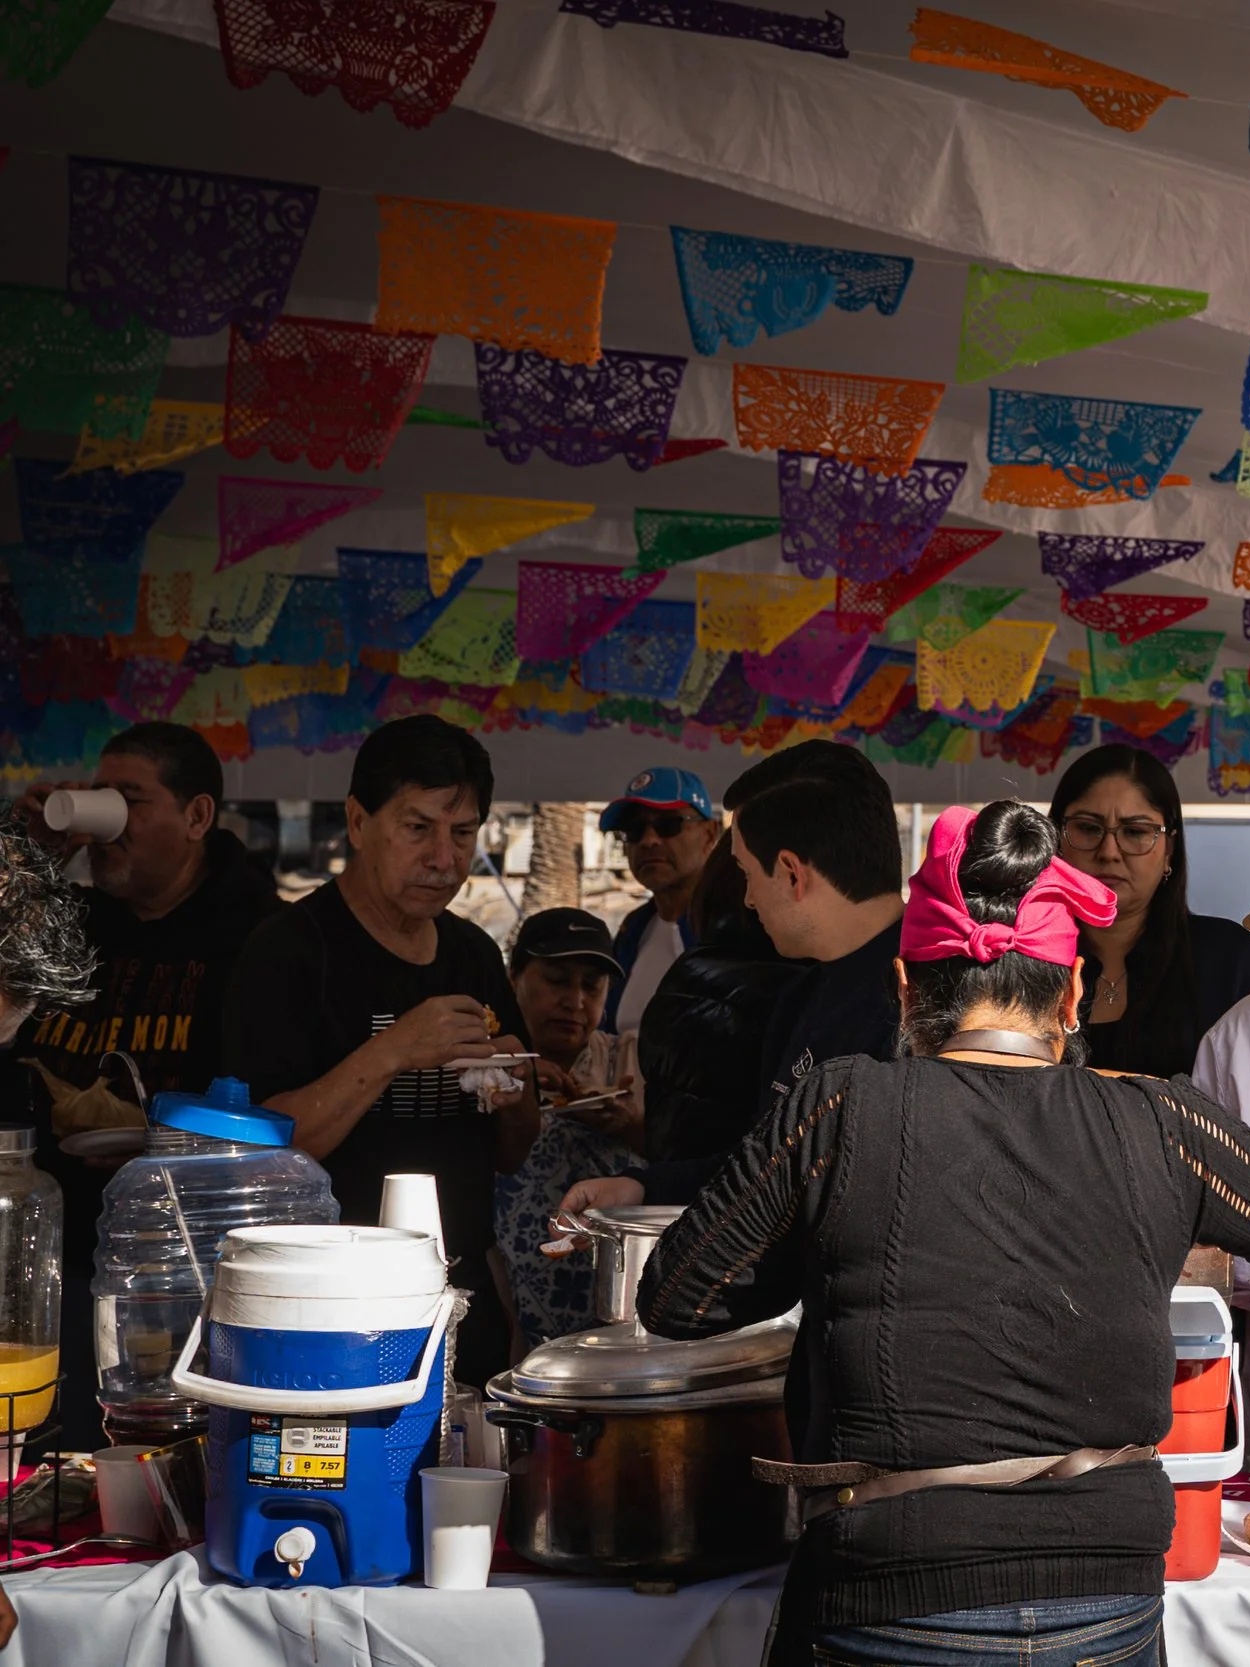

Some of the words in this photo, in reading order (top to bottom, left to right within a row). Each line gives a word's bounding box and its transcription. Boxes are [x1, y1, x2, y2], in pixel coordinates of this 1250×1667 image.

[130, 1014, 192, 1052] MOM
[286, 1461, 292, 1470] 2
[304, 1461, 311, 1470] 8
[320, 1462, 341, 1470] 7.57
